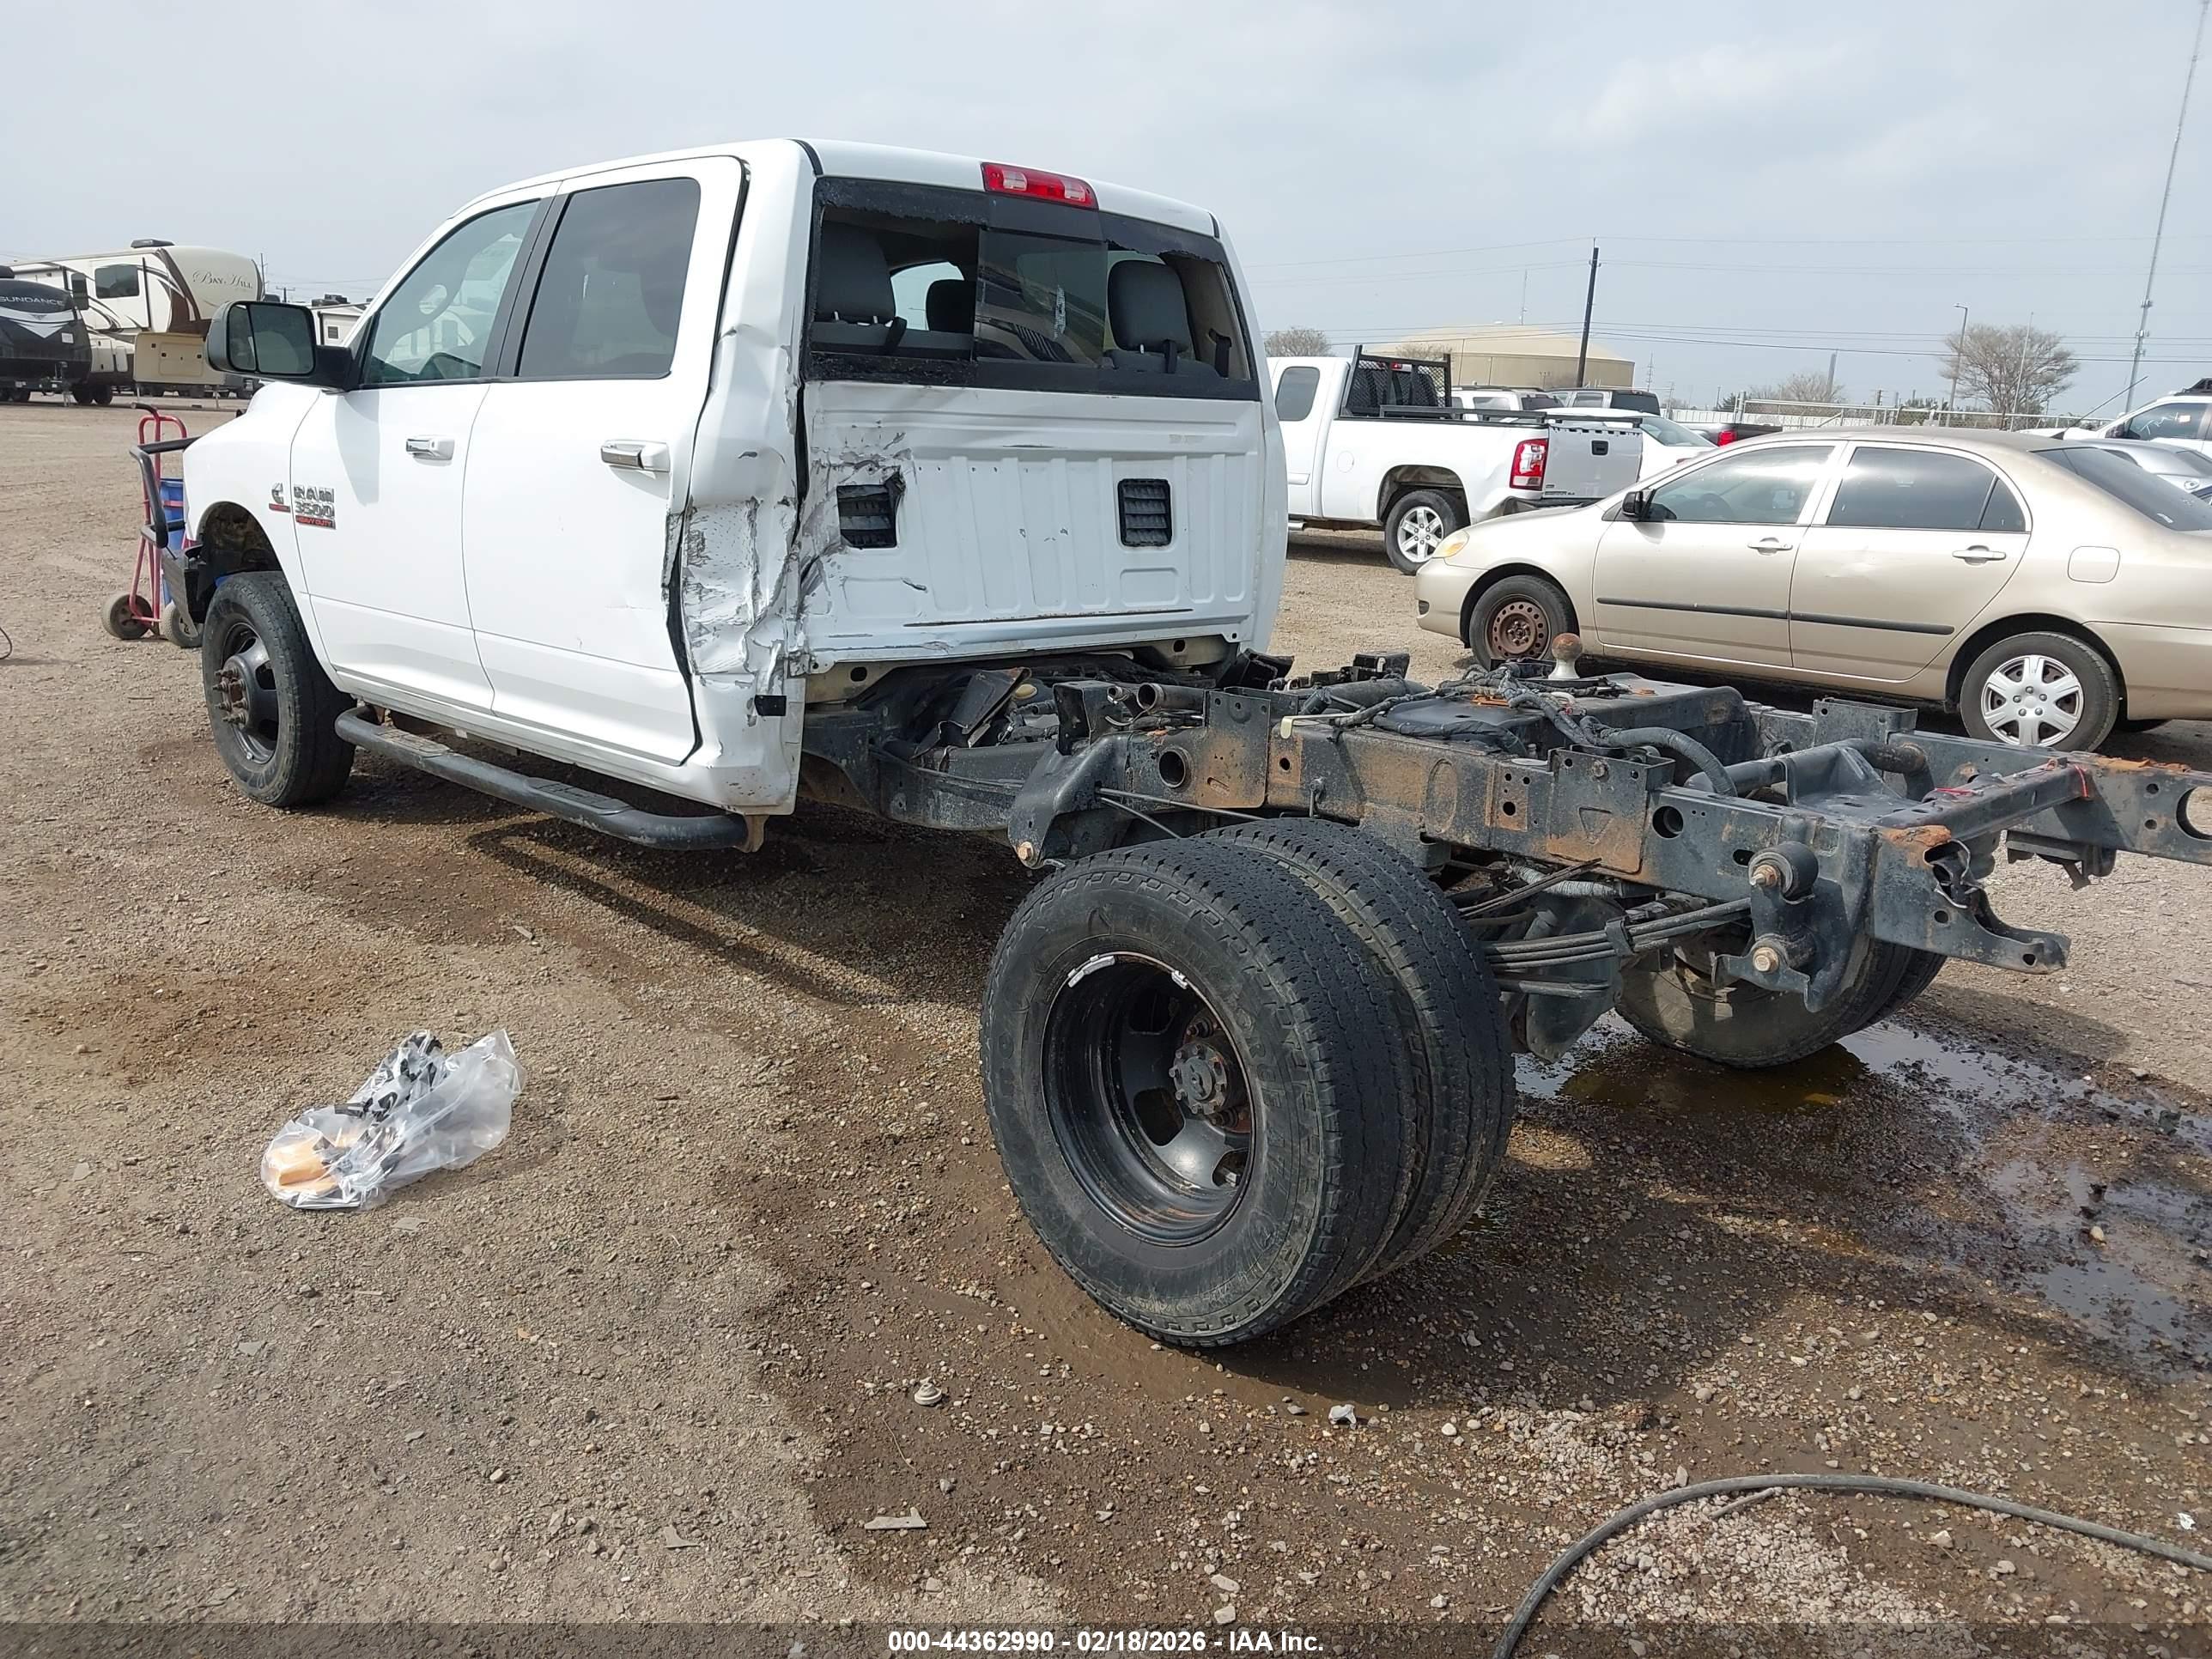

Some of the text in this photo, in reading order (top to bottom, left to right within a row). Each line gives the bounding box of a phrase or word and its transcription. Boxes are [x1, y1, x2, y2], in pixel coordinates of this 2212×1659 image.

[229, 274, 253, 289] HILL
[0, 295, 65, 306] SUNDANCE
[293, 484, 335, 503] RAM
[295, 501, 336, 519] 3500
